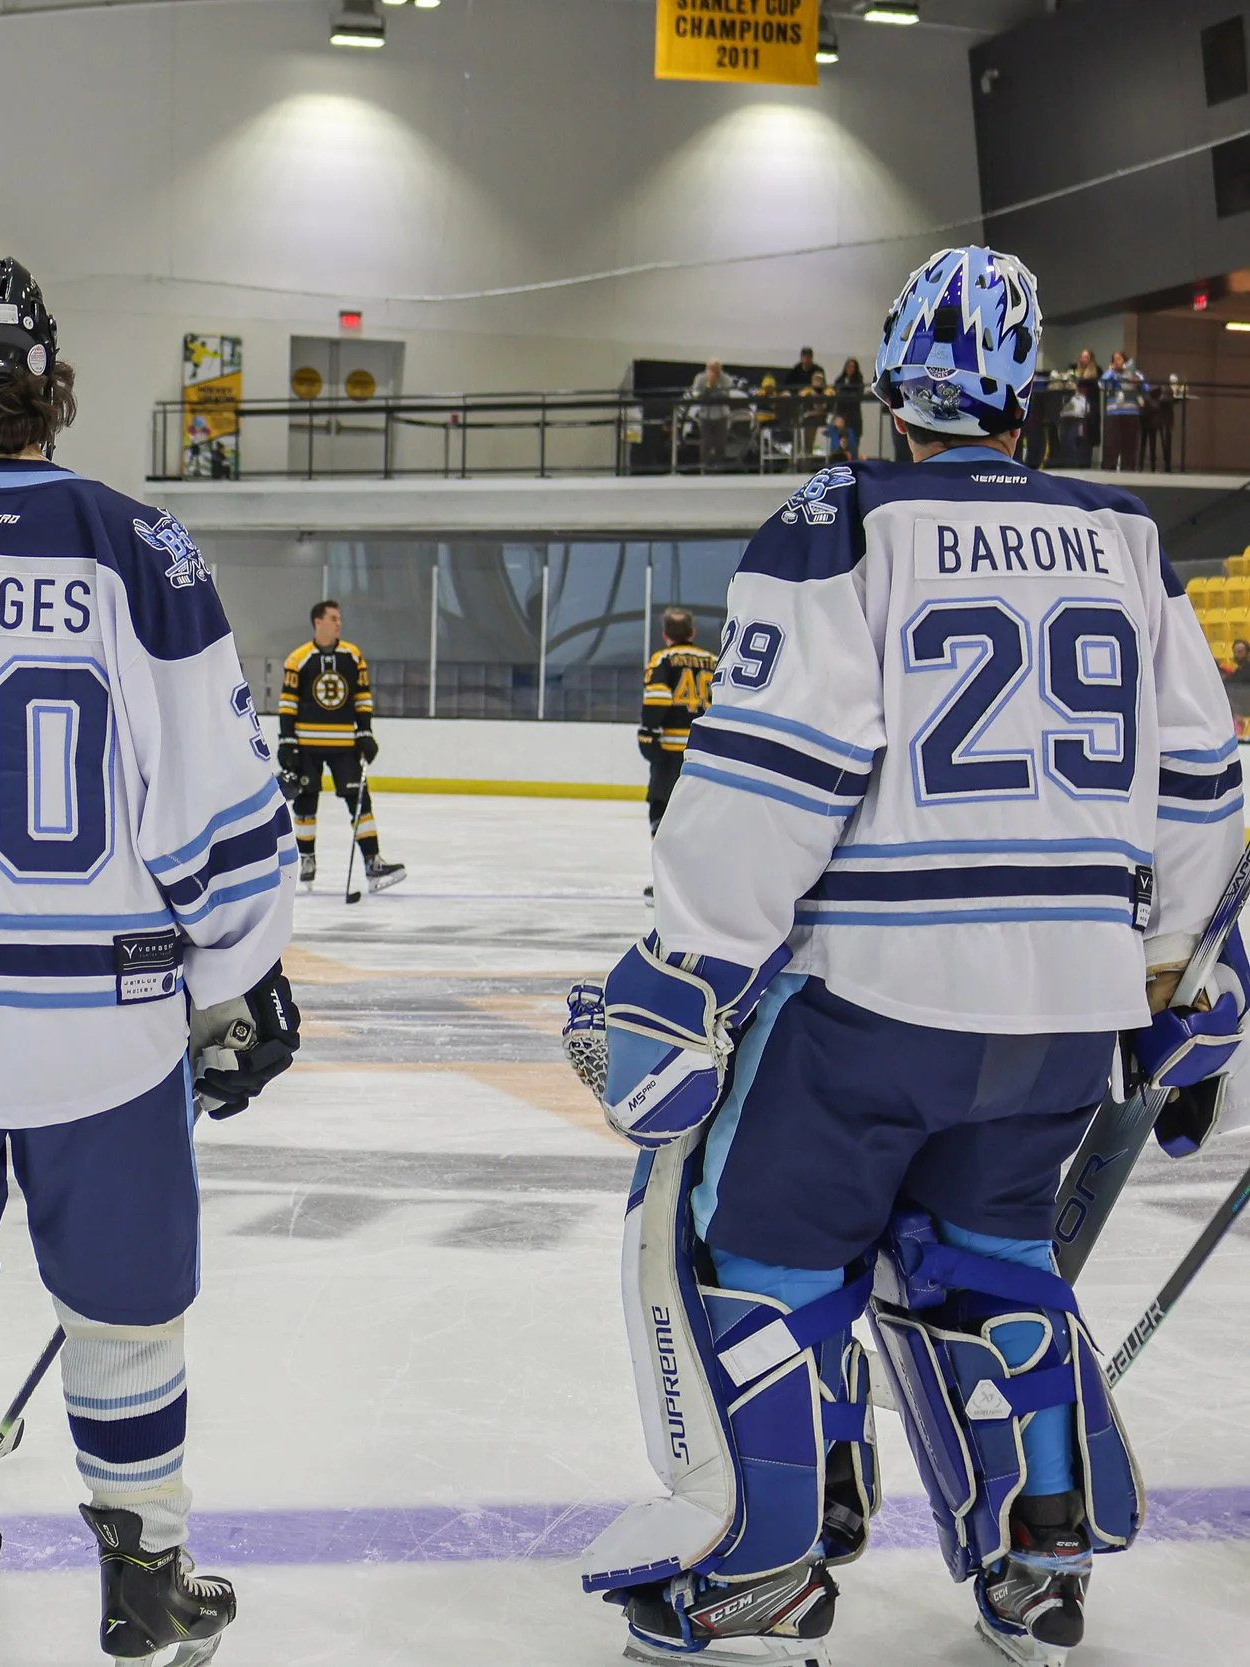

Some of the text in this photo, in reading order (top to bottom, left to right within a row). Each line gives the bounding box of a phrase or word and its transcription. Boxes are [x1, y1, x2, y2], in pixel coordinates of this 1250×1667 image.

[675, 17, 802, 45] CHAMPIONS
[716, 46, 760, 69] 2011
[937, 525, 1110, 575] BARONE
[900, 595, 1144, 808] 29
[270, 988, 288, 1031] TRUE
[651, 1305, 690, 1466] SUPREME
[710, 1593, 754, 1623] CCM
[993, 1587, 1009, 1602] CCM
